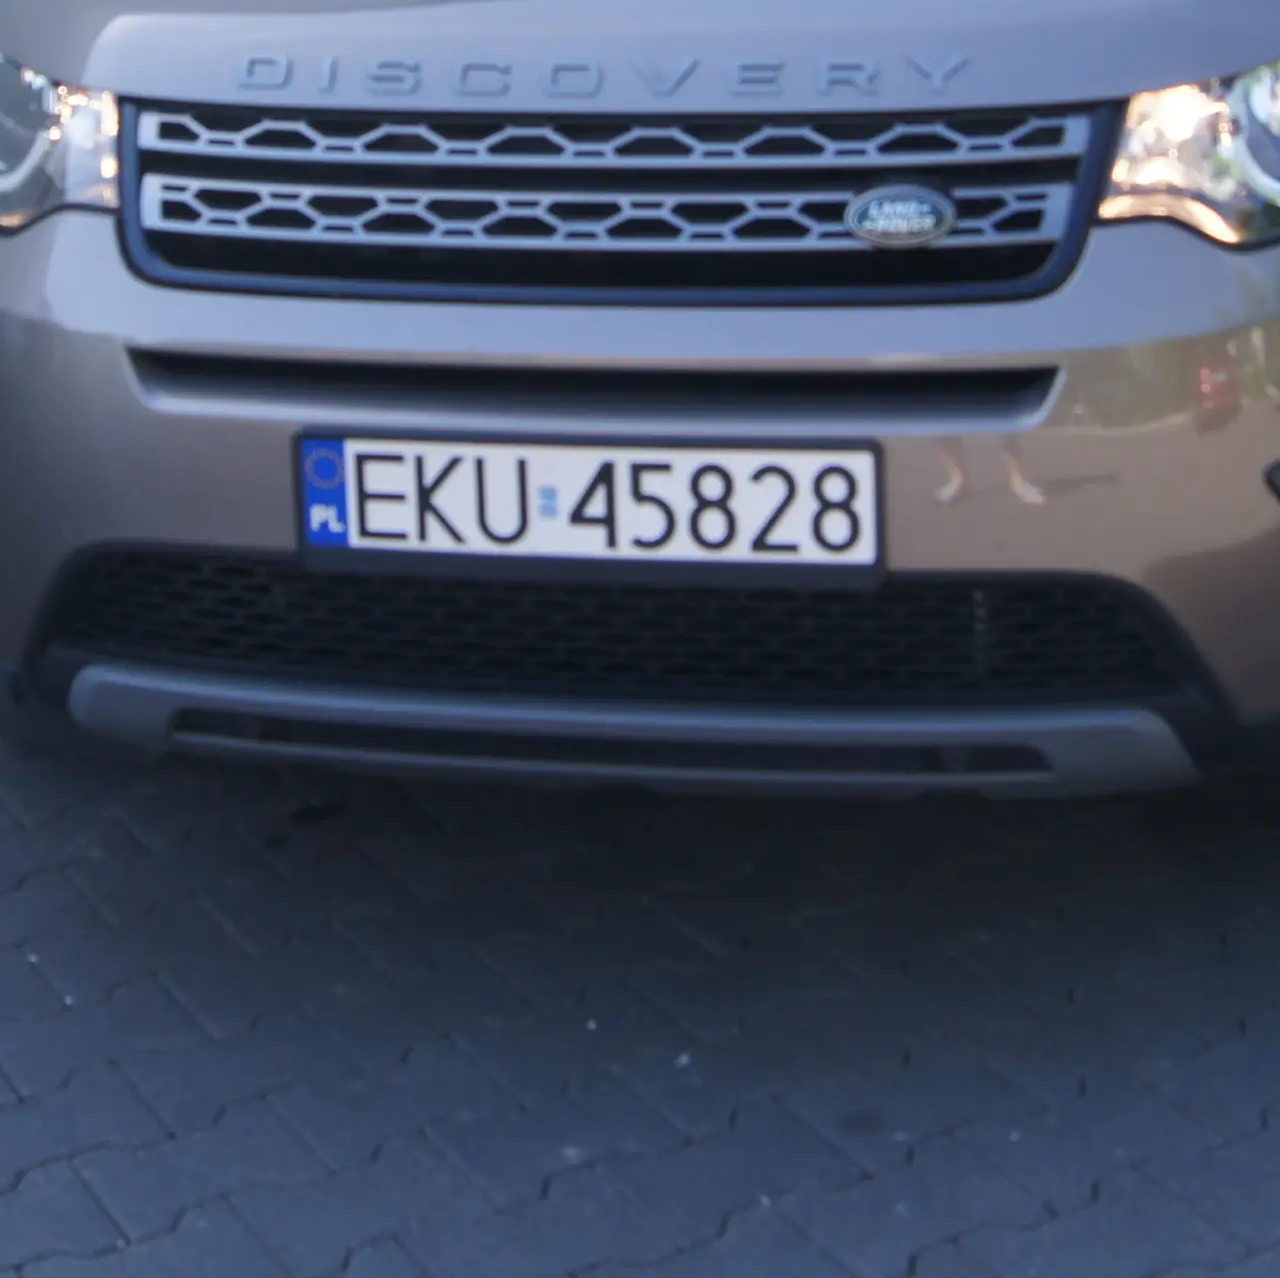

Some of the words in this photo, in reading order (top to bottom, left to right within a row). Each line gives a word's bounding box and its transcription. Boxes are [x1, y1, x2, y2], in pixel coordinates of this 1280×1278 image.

[237, 54, 970, 98] DISCOVERY
[309, 503, 345, 534] PL
[354, 453, 531, 544] EKU
[569, 460, 862, 554] 45828
